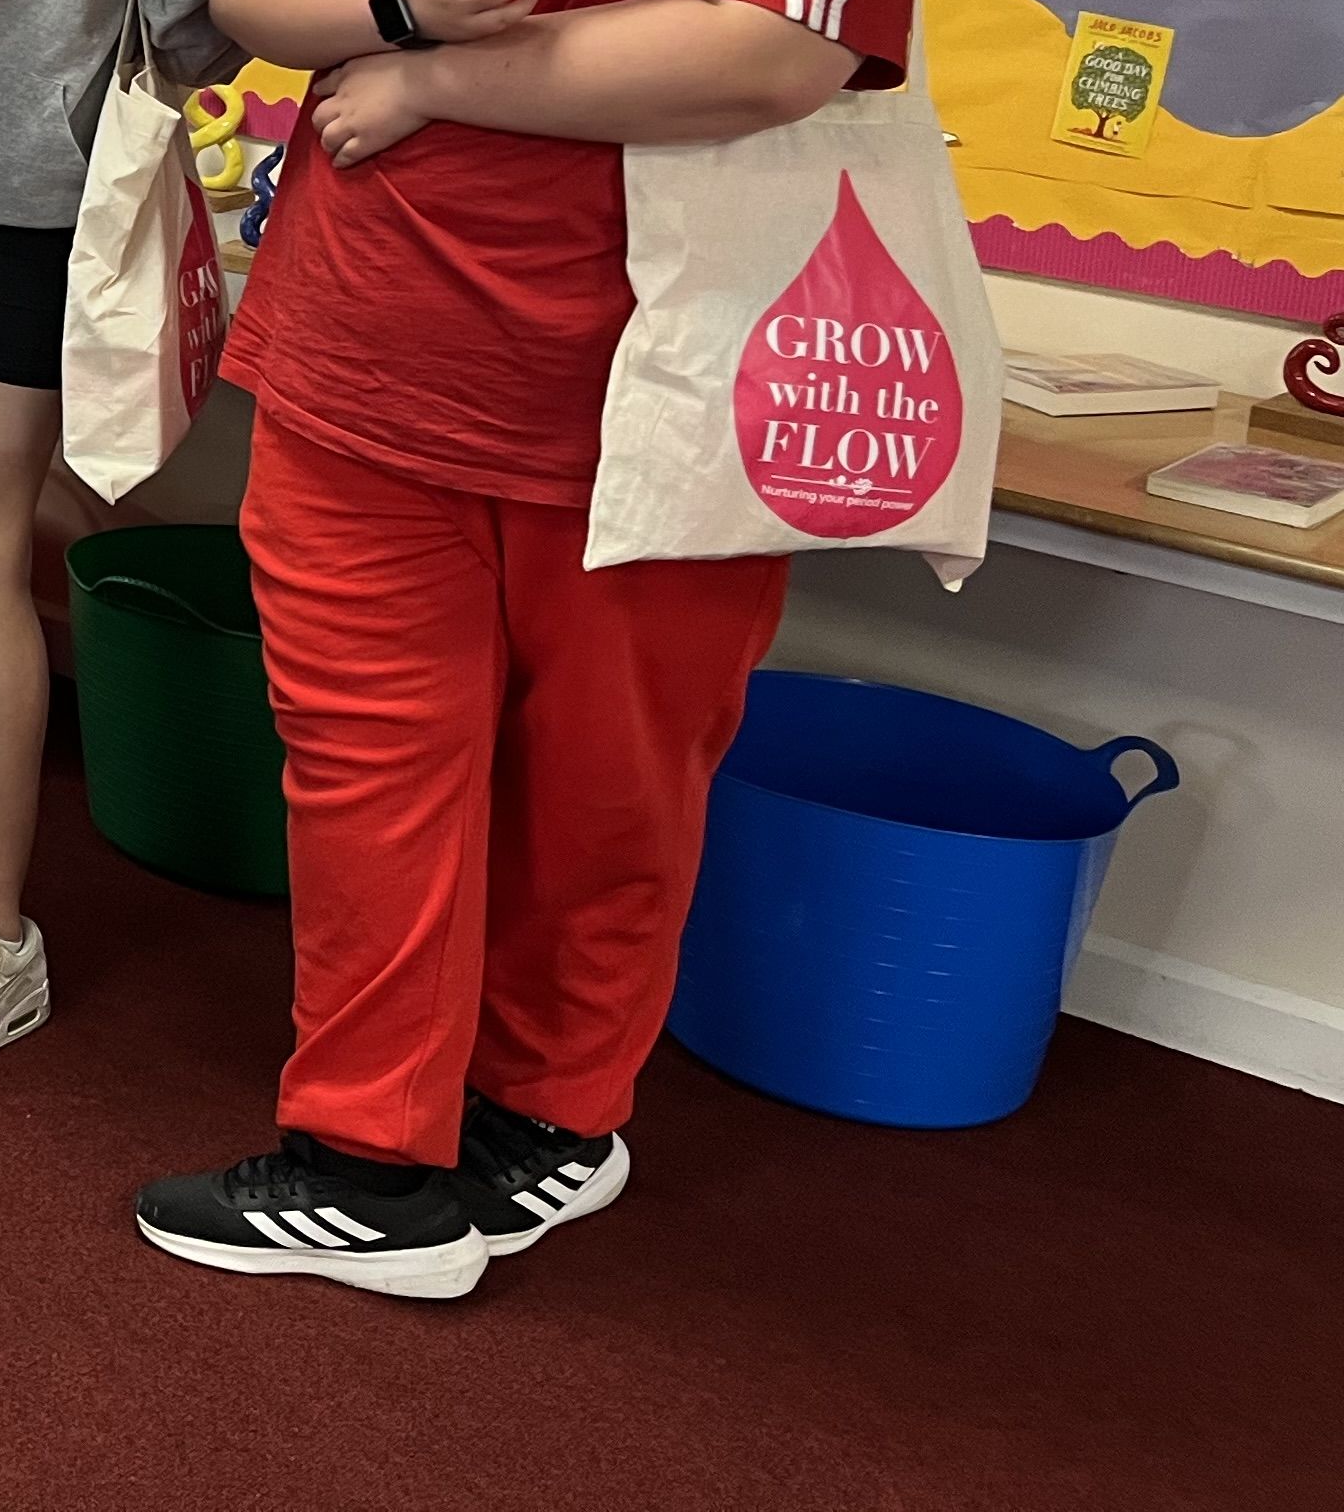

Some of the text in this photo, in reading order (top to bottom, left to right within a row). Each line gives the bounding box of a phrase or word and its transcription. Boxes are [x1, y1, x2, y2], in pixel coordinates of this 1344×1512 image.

[1120, 25, 1163, 43] JACOBS
[1085, 55, 1150, 78] GOOD DAY
[1078, 76, 1142, 101] CLIMBING
[1087, 92, 1129, 111] TREES
[765, 314, 942, 374] GROW
[767, 372, 939, 424] with the
[758, 419, 936, 480] FLOW
[762, 483, 817, 505] Nurturing
[819, 492, 845, 506] your
[847, 494, 880, 508] period
